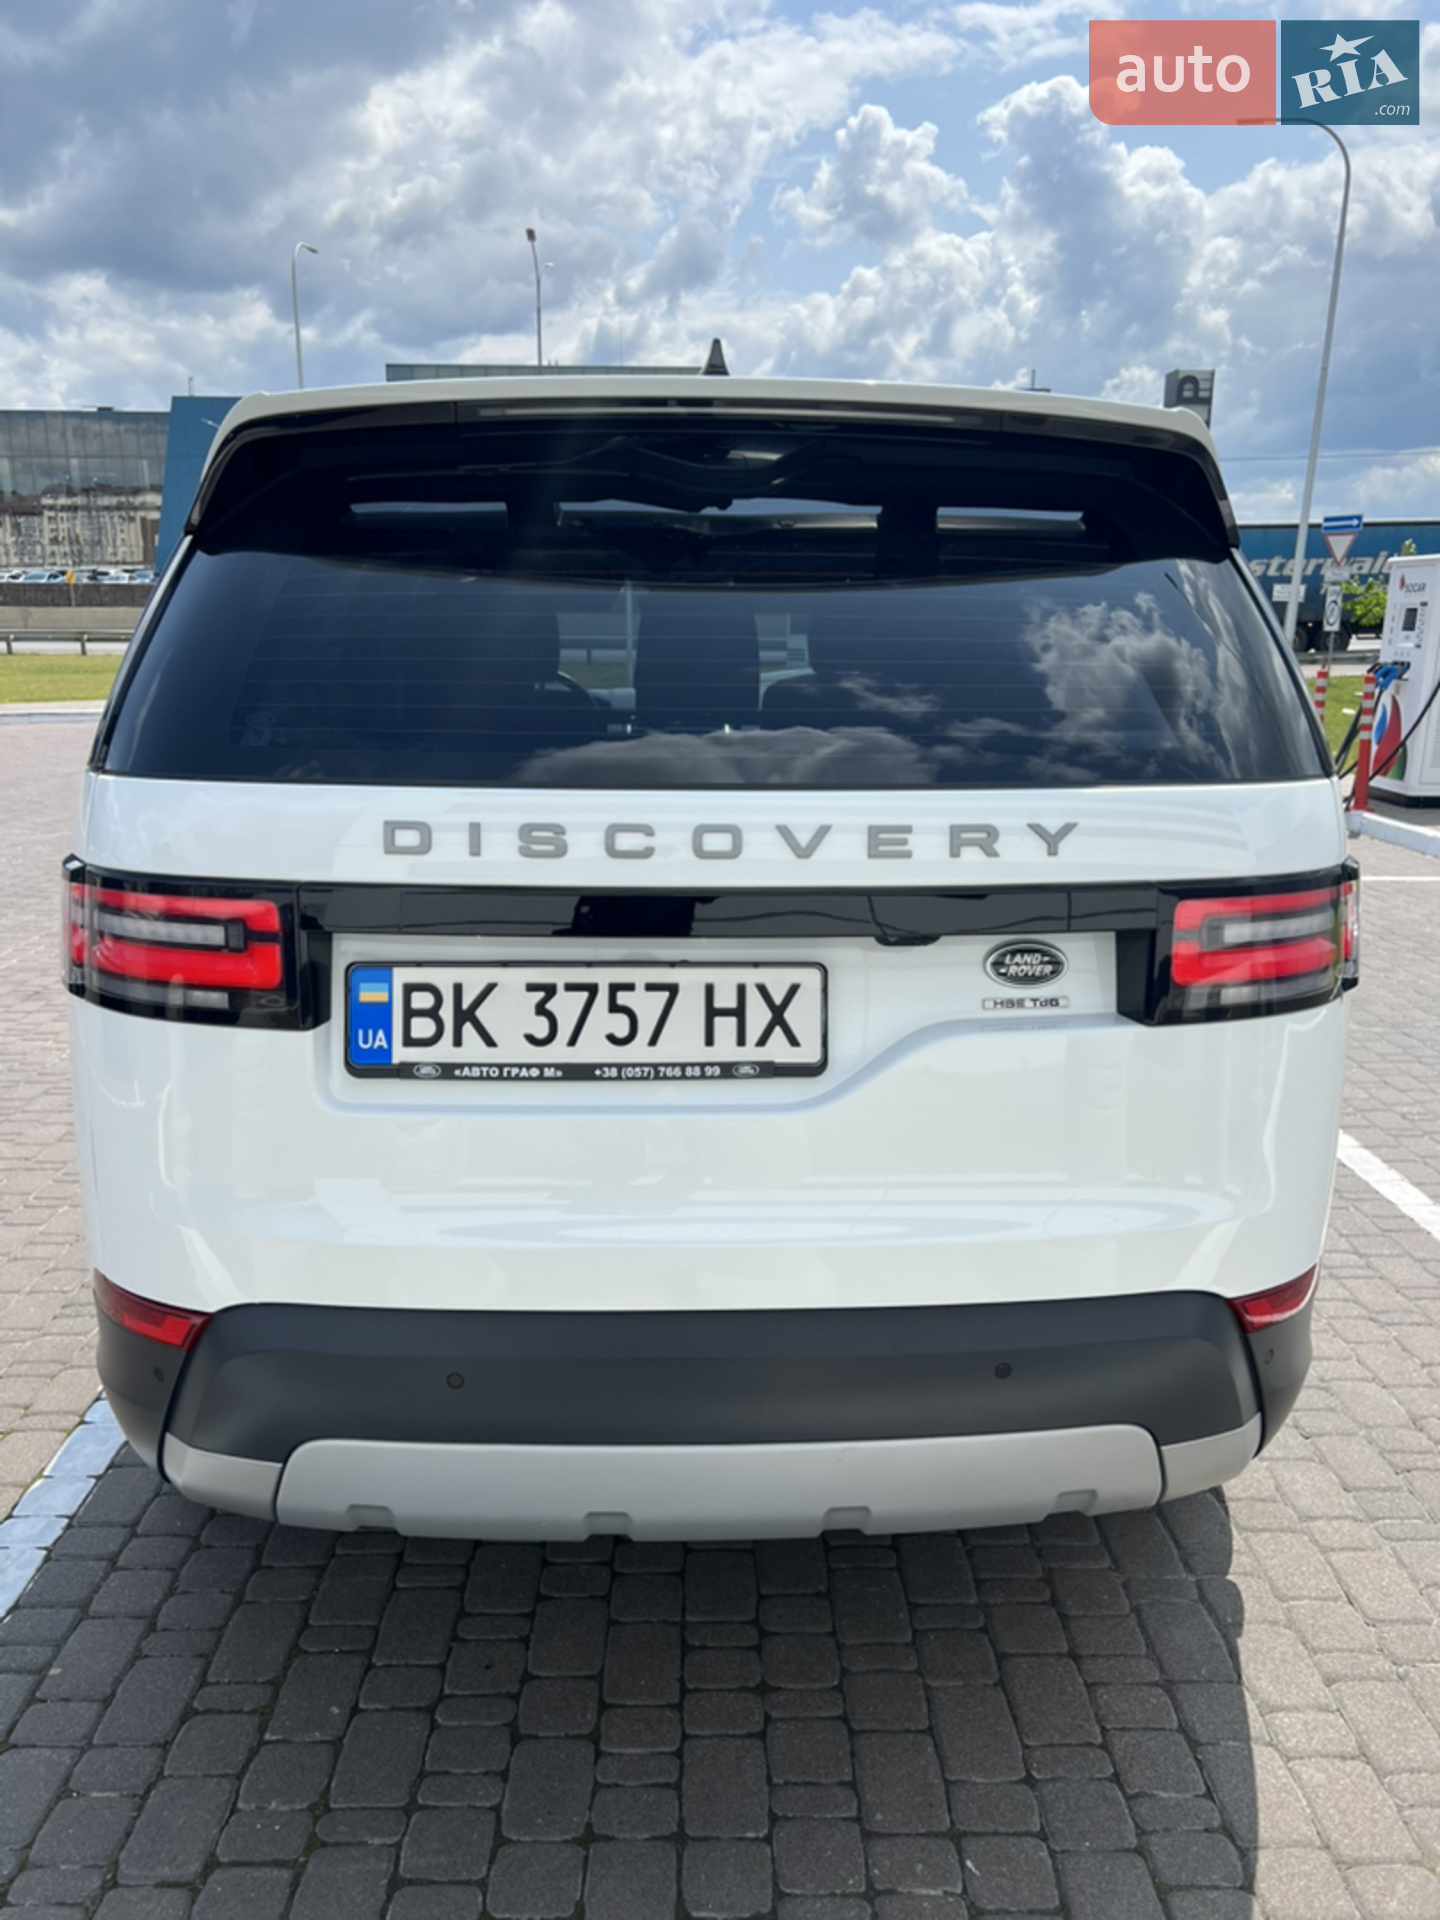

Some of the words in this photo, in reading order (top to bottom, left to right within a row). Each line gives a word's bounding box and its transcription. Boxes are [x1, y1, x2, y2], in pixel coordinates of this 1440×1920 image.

[382, 819, 1079, 860] DISCOVERY
[401, 982, 499, 1048] BK
[523, 982, 680, 1048] 3757
[704, 982, 802, 1048] HX
[358, 1028, 389, 1050] UA
[502, 1066, 541, 1078] ГРАФ
[594, 1066, 618, 1078] +38
[620, 1066, 655, 1080] (057)
[657, 1066, 682, 1078] 766
[684, 1066, 702, 1077] 88
[704, 1065, 721, 1077] 99
